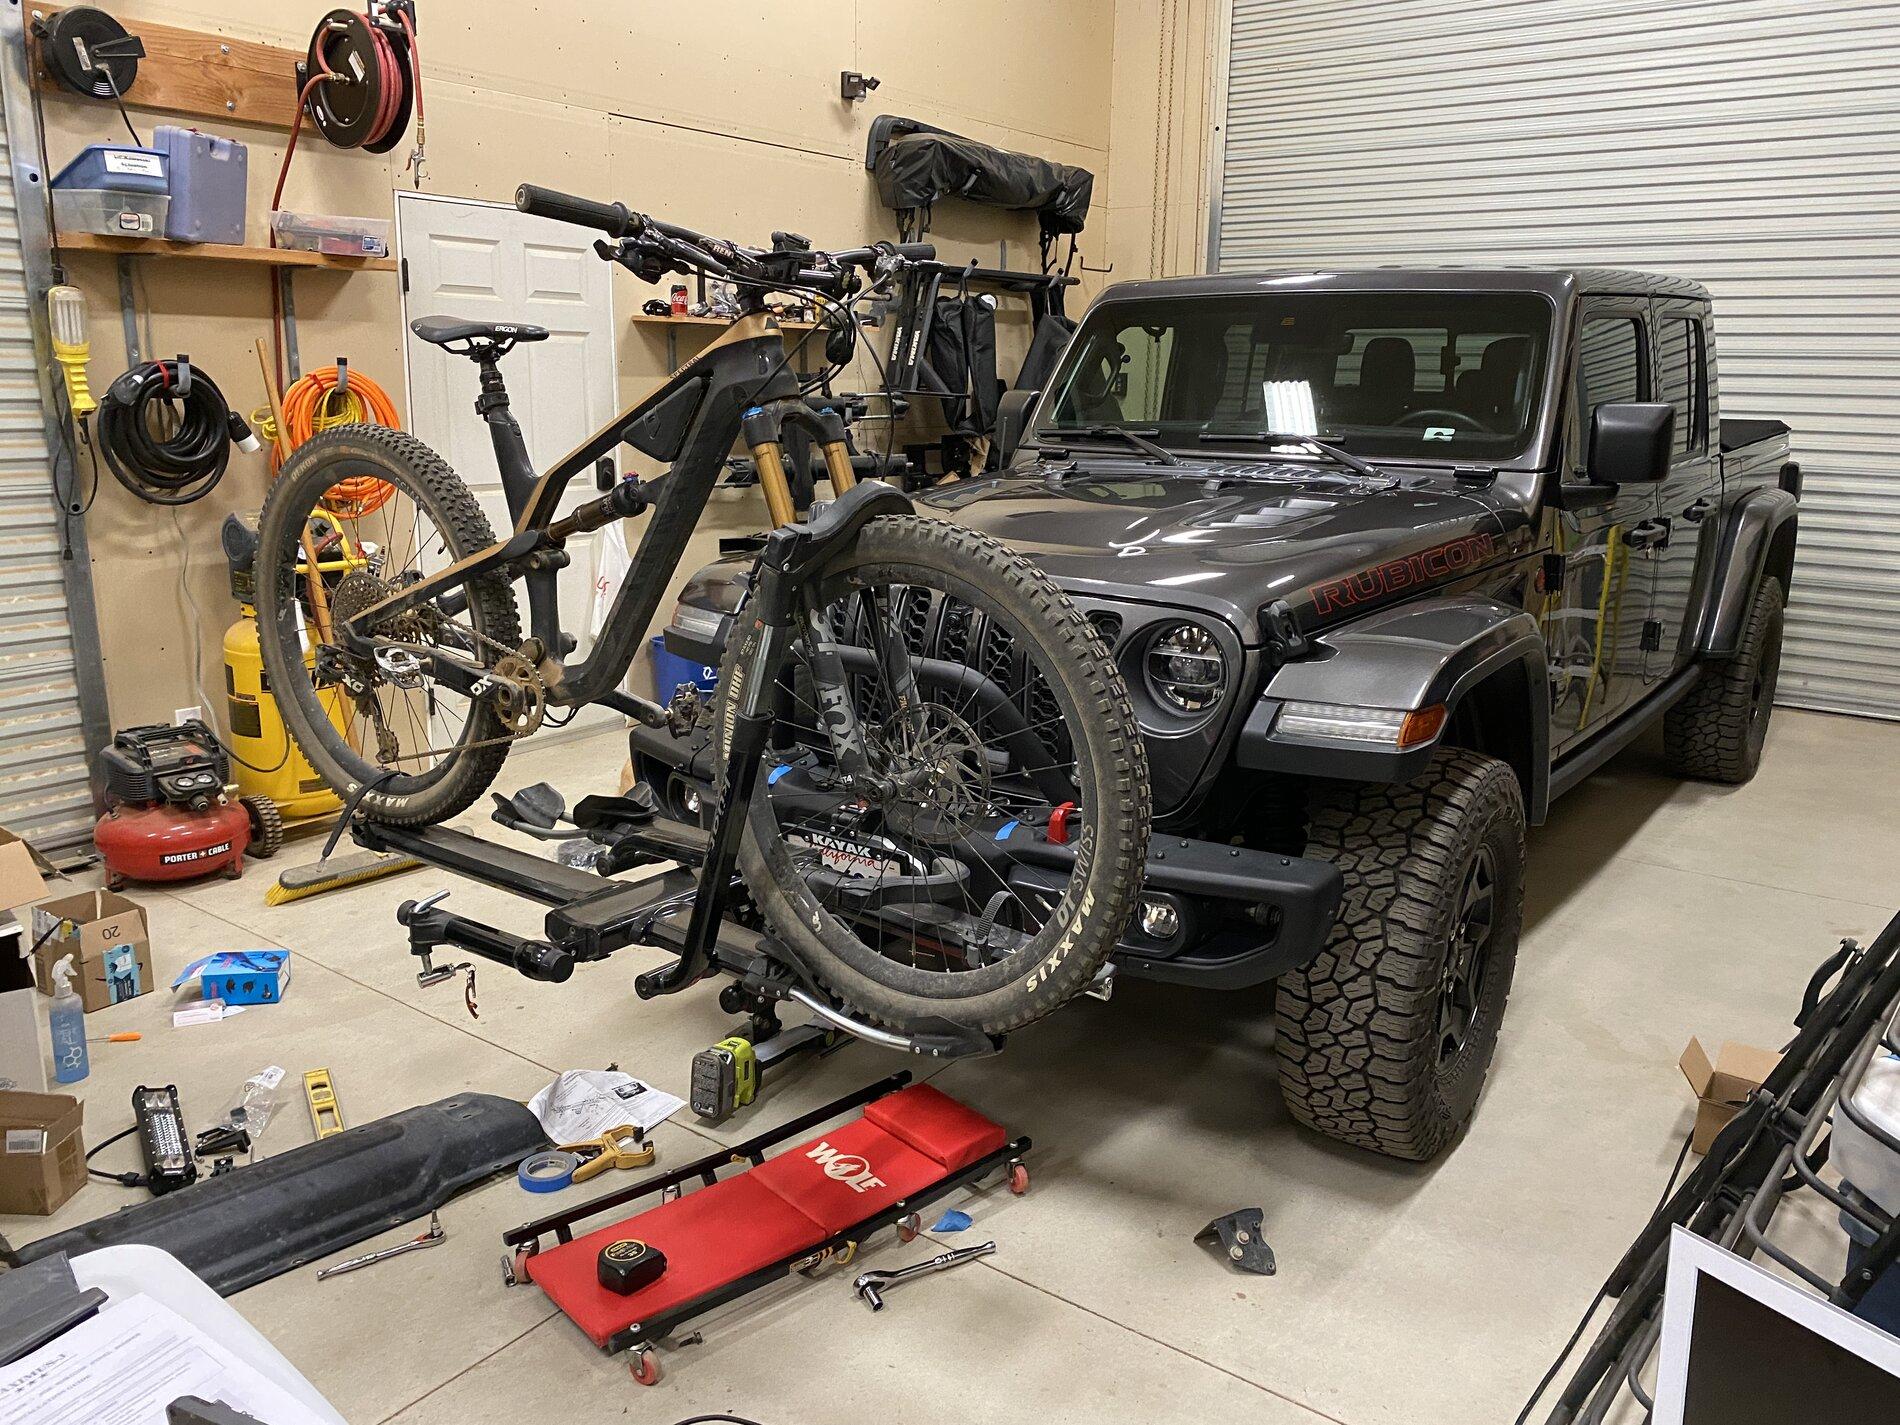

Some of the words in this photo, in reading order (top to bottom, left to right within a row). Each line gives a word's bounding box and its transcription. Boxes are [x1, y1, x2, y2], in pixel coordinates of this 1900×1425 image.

[494, 325, 518, 334] ERGON
[891, 326, 903, 361] YAKIMA
[908, 330, 921, 366] YAKIMA
[1309, 533, 1495, 615] RUBICON
[722, 699, 737, 761] MINION
[819, 685, 861, 760] FOX
[346, 782, 410, 808] MAXXS
[164, 852, 198, 864] PORTER
[208, 842, 230, 856] CABLE
[811, 833, 871, 858] KAYAK
[1056, 888, 1076, 929] DT
[1072, 823, 1095, 892] SWISS
[102, 925, 121, 940] 20
[1026, 887, 1096, 993] MAXXIS
[805, 1141, 888, 1193] WOLF
